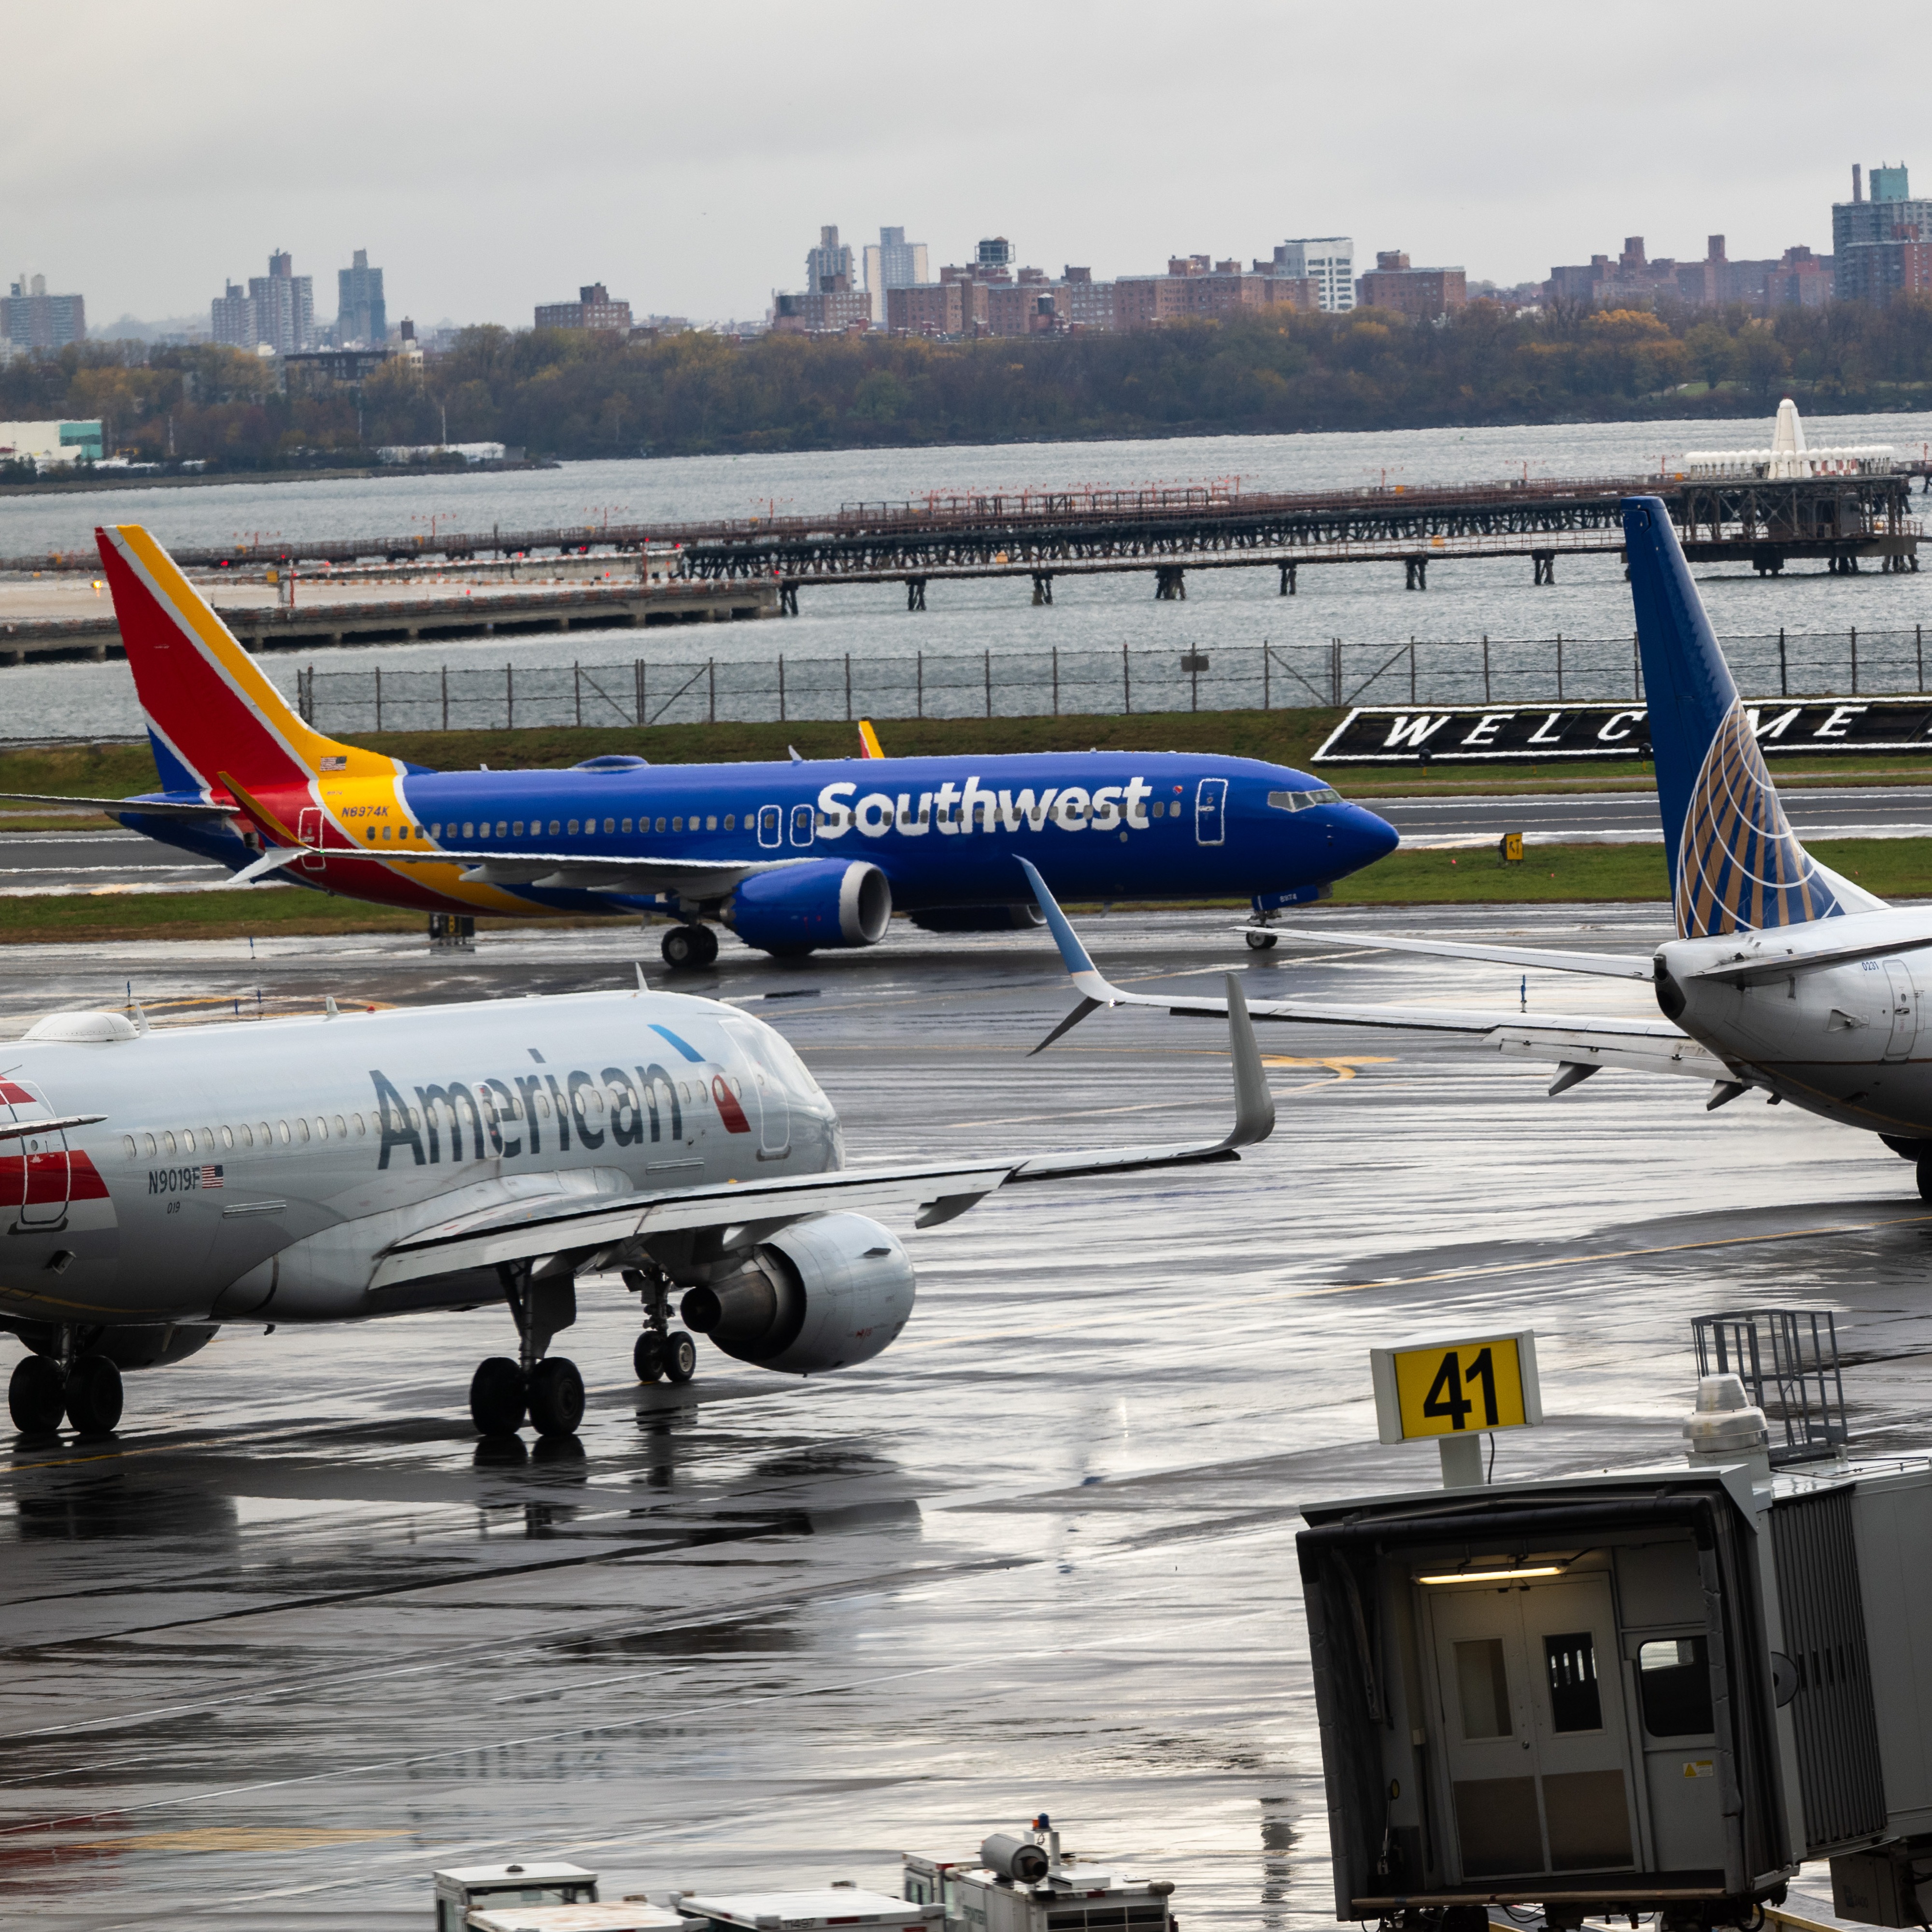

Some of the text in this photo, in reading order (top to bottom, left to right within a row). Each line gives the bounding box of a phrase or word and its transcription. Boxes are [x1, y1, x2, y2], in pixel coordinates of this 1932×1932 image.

[1383, 706, 1868, 747] WELCME
[341, 806, 389, 817] N8974K
[816, 776, 1152, 839] Southwest
[1862, 961, 1879, 971] 0231
[369, 1049, 682, 1170] American
[149, 1167, 200, 1194] N9019F
[167, 1201, 180, 1214] 019
[1423, 1348, 1499, 1430] 41
